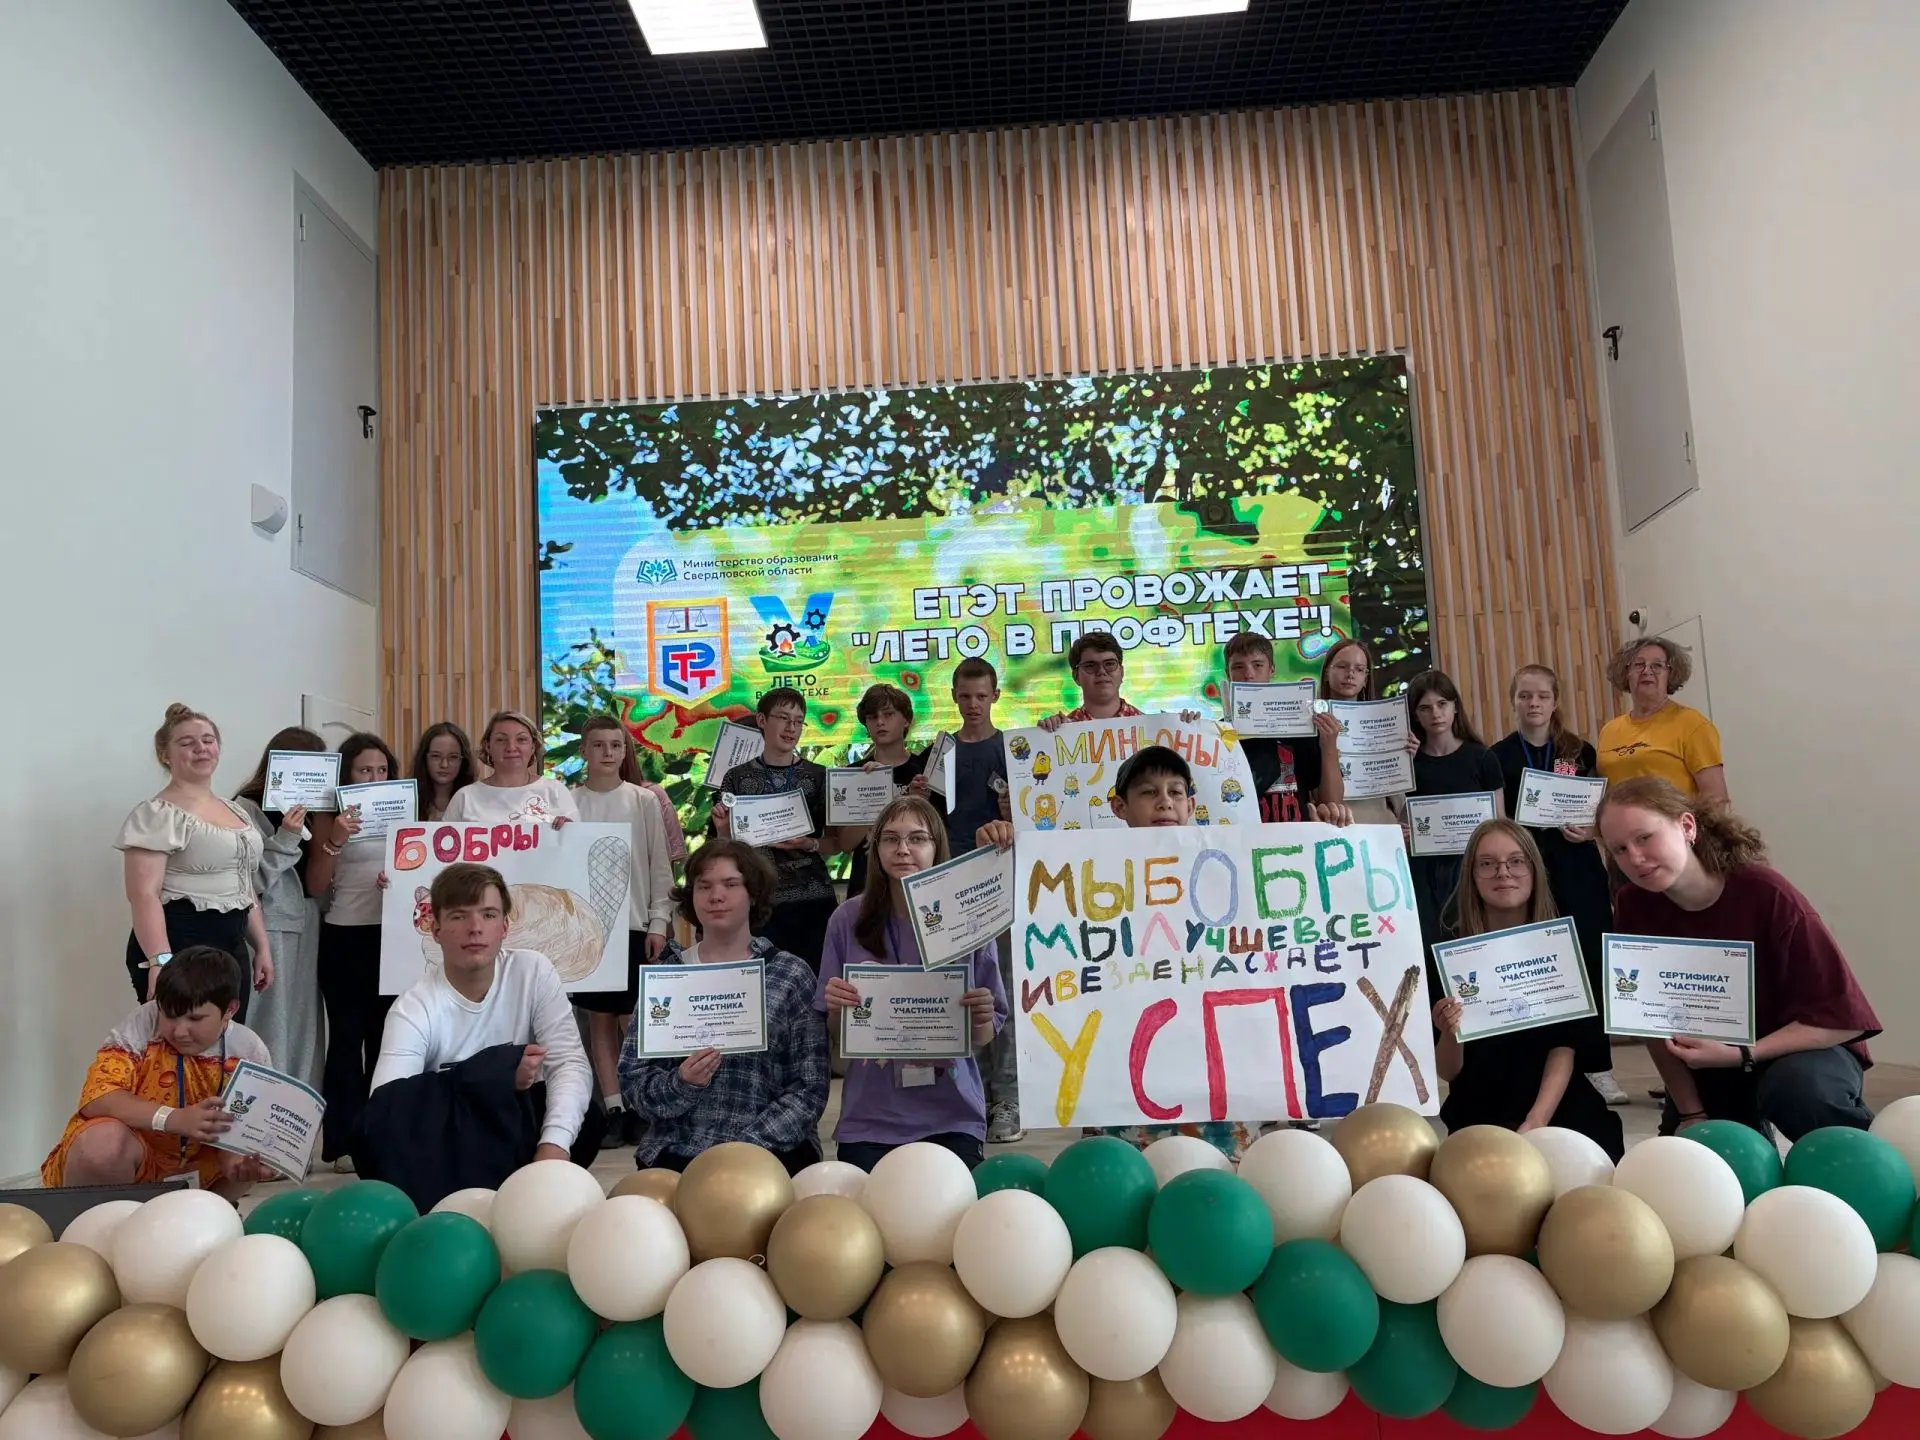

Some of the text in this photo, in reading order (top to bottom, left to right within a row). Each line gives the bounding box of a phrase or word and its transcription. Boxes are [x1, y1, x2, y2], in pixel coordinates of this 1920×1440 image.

[683, 553, 839, 570] Министерство образования
[683, 565, 813, 582] Свердловской области
[913, 563, 1329, 620] ЕТЭТ ПРОВОЖАЕТ
[851, 624, 990, 664] "ЛЕТО
[1005, 624, 1035, 656] В
[770, 674, 817, 688] ЛЕТО
[394, 824, 539, 871] БОБРЫ
[954, 872, 1003, 900] СЕРТИФИКАТ
[959, 884, 1002, 908] УЧАСТНИКА
[1494, 954, 1558, 973] СЕРТИФИКАТ
[1500, 965, 1558, 983] УЧАСТНИКА
[1659, 971, 1730, 983] СЕРТИФИКАТ
[1663, 981, 1726, 993] УЧАСТНИКА
[688, 992, 747, 1002] СЕРТИФИКАТ
[692, 1002, 744, 1012] УЧАСТНИКА
[893, 1006, 946, 1014] УЧАСТНИКА
[1031, 963, 1430, 1128] УСПЕХ
